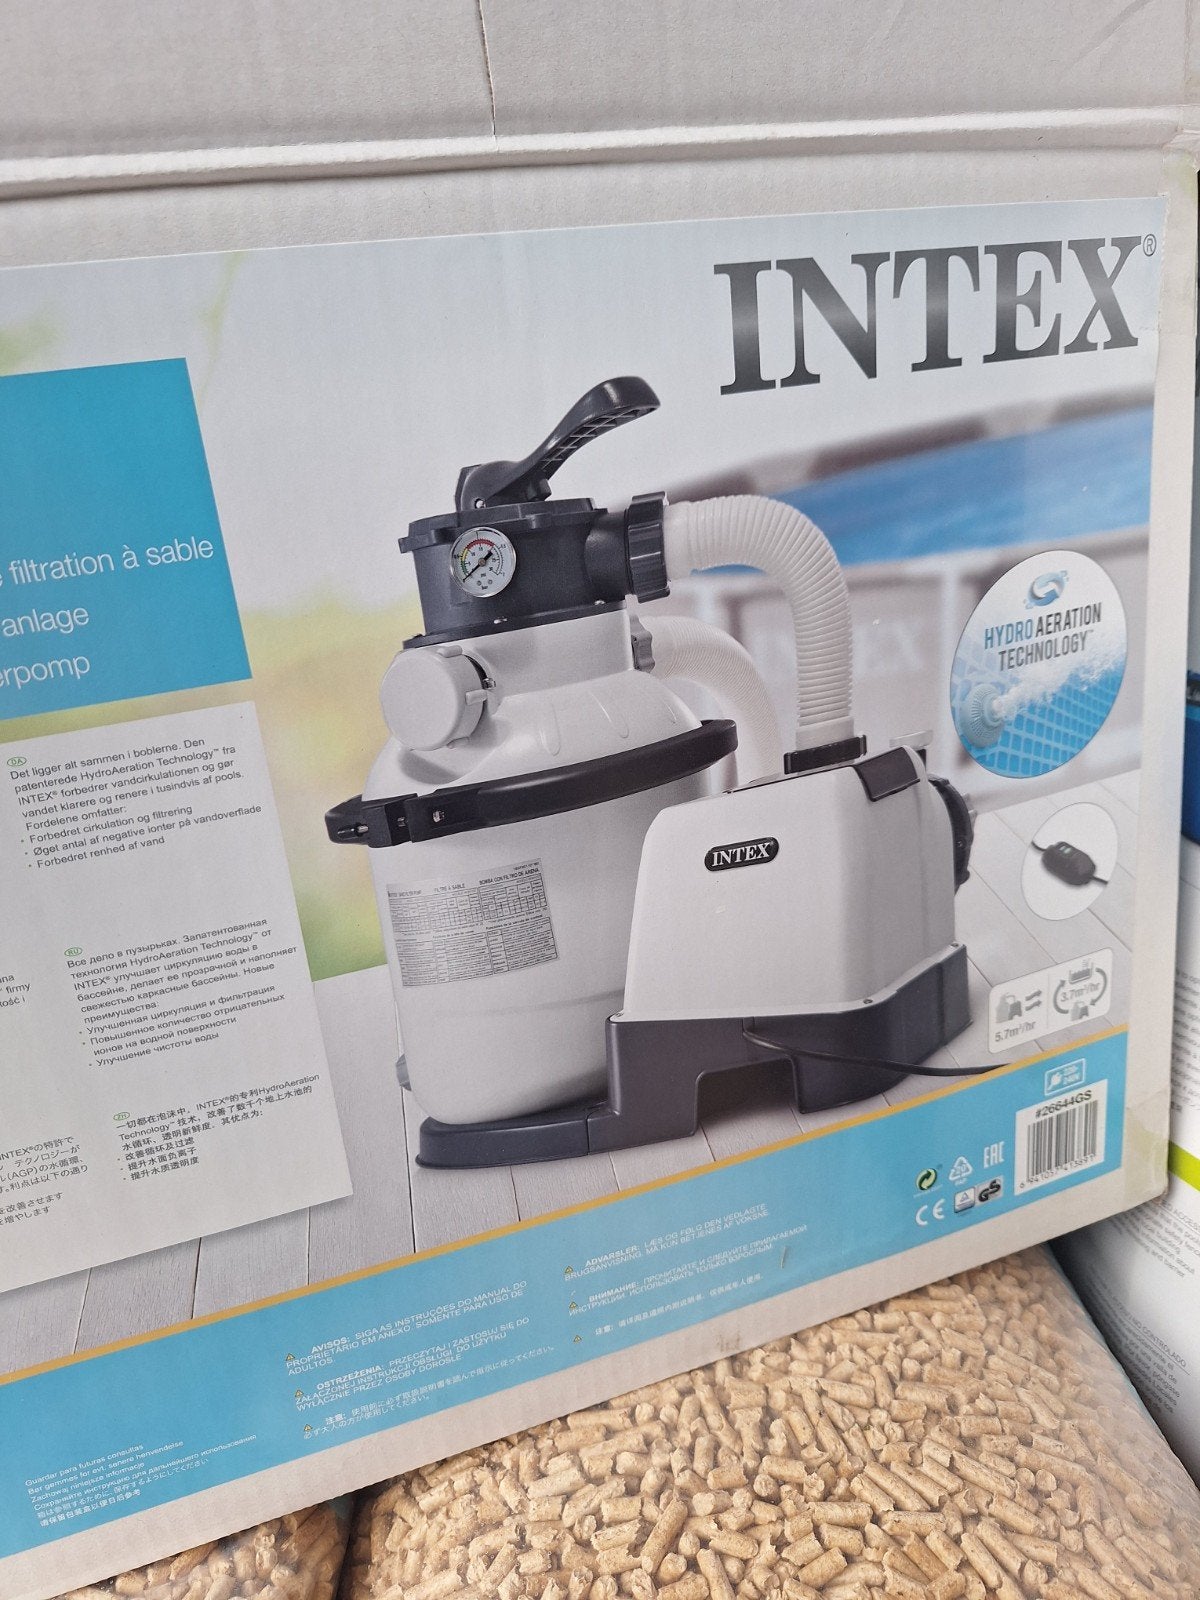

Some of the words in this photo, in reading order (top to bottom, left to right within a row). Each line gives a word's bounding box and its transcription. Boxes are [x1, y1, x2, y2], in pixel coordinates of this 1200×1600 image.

[8, 552, 115, 585] filtration
[122, 545, 140, 570] à
[146, 536, 214, 567] sable
[1, 607, 90, 637] anlage
[0, 655, 90, 689] rpomp
[9, 769, 30, 779] Det
[31, 764, 61, 776] ligger
[64, 760, 77, 770] alt
[80, 753, 125, 767] sammen
[133, 744, 181, 757] boblerne.
[183, 739, 205, 748] Den
[14, 774, 77, 795] patenterede
[80, 761, 154, 781] HydroAeration
[222, 746, 235, 754] fra
[22, 804, 58, 818] vandet
[59, 798, 96, 811] klarere
[99, 796, 112, 804] og
[114, 789, 148, 800] renere
[156, 779, 200, 792] tusindvis
[203, 775, 212, 784] af
[214, 771, 244, 784] pools.
[60, 783, 108, 797] forbedrer
[111, 766, 199, 788] vandcirkulationen
[202, 763, 214, 772] og
[217, 760, 234, 770] gør
[25, 815, 78, 831] Fordelene
[81, 806, 126, 820] omfatter:
[29, 827, 81, 843] Forbedret
[83, 818, 134, 832] cirkulation
[137, 815, 150, 823] og
[152, 806, 192, 819] filtrering
[33, 844, 60, 856] Øget
[62, 838, 87, 850] antal
[89, 835, 99, 844] af
[102, 828, 145, 842] negative
[178, 818, 191, 829] på
[193, 805, 261, 824] vandoverflade
[37, 851, 87, 868] Forbedret
[89, 843, 125, 857] renhed
[128, 840, 137, 850] af
[140, 836, 165, 847] vand
[66, 959, 86, 968] Все
[89, 953, 114, 964] дело
[125, 939, 180, 955] пузырьках.
[182, 919, 267, 942] Запатентованная
[70, 961, 127, 979] технология
[129, 946, 198, 966] HydroAeration
[261, 929, 271, 937] от
[77, 986, 127, 1001] бассейне,
[130, 976, 164, 991] делает
[181, 959, 237, 978] прозрачной
[248, 946, 296, 962] наполняет
[113, 966, 160, 983] улучшает
[163, 952, 223, 970] циркуляцию
[225, 946, 250, 956] воды
[80, 995, 134, 1012] свежестью
[137, 983, 189, 999] каркасные
[191, 972, 240, 987] бассейны.
[243, 963, 274, 975] Новые
[84, 1001, 159, 1023] преимущества:
[86, 1015, 148, 1034] Улучшенная
[150, 1001, 207, 1020] циркуляция
[218, 986, 275, 1004] фильтрация
[90, 1025, 155, 1045] Повышенное
[157, 1012, 211, 1029] количество
[93, 1044, 123, 1055] ионов
[125, 1040, 137, 1048] на
[139, 1031, 174, 1044] водной
[176, 1017, 236, 1036] поверхности
[95, 1048, 151, 1066] Улучшение
[153, 1039, 192, 1052] чистоты
[194, 1032, 219, 1042] воды
